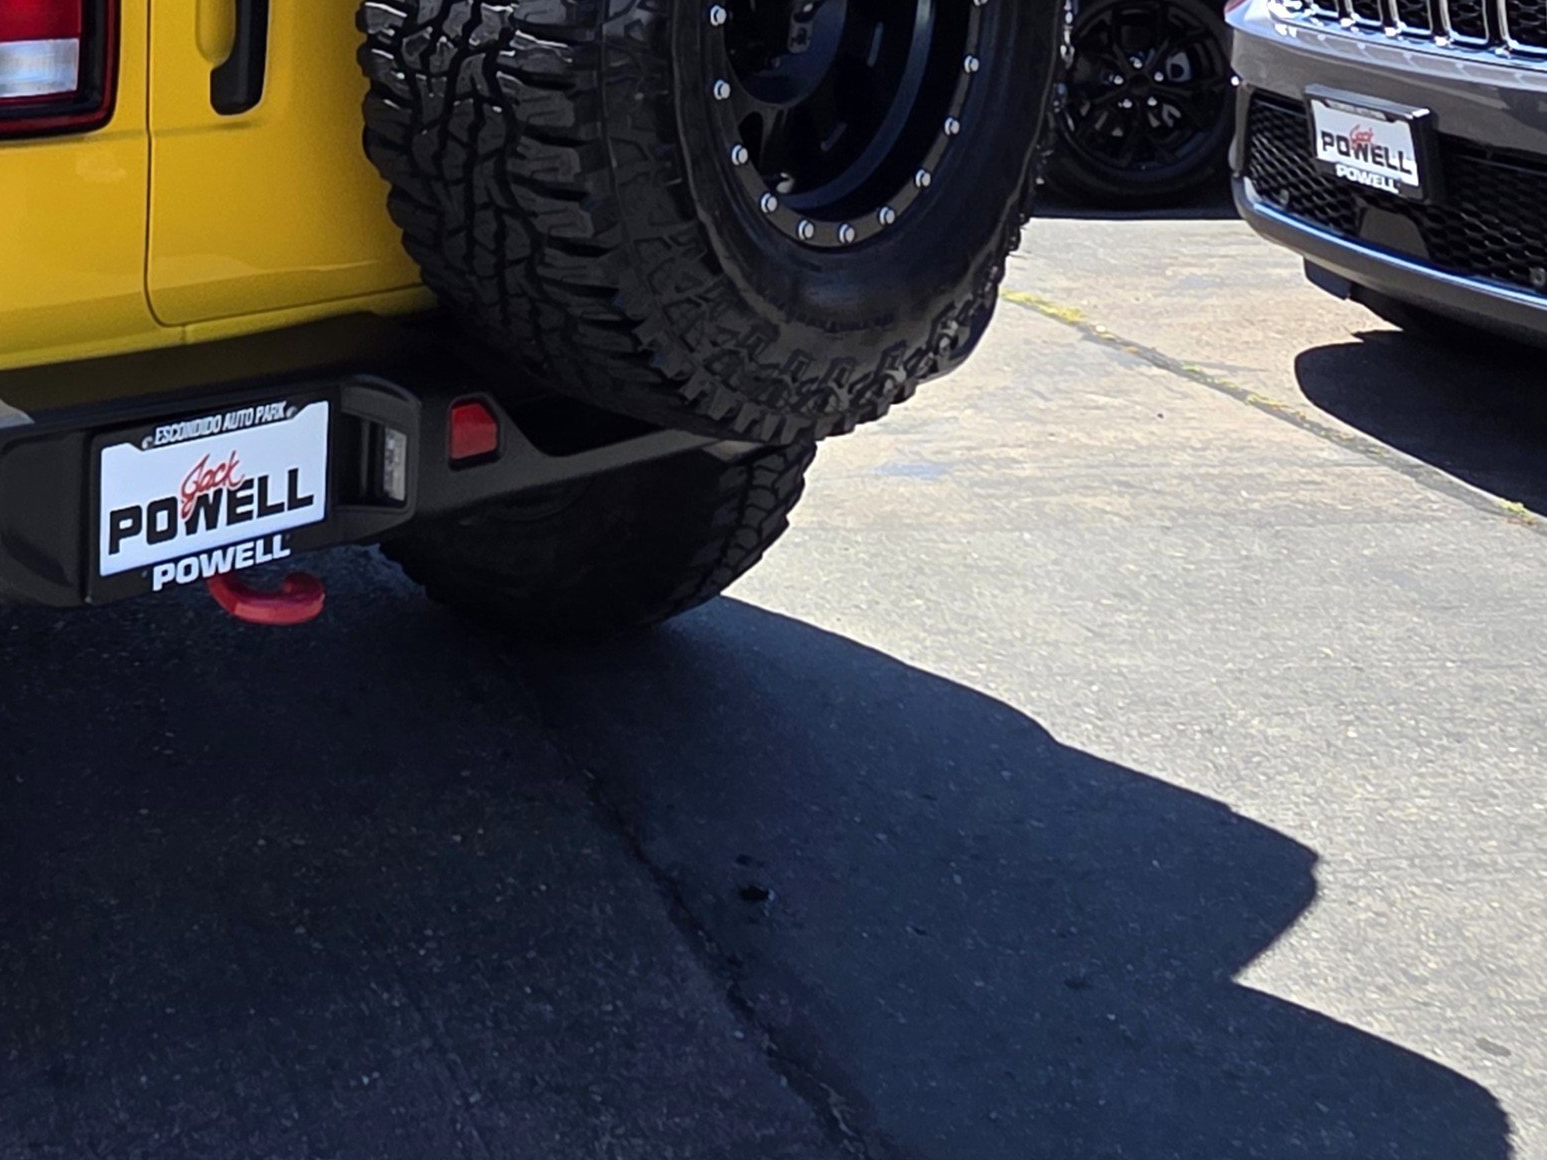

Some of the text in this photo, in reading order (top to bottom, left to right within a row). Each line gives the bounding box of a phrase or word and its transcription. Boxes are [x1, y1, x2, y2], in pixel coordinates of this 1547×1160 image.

[1321, 130, 1412, 175] POWELL
[1335, 163, 1399, 195] POWELL
[155, 401, 287, 445] ESCONDIDO AUTO PARK
[181, 450, 245, 520] Jack
[108, 467, 315, 556] POWELL
[153, 534, 291, 591] POWELL
